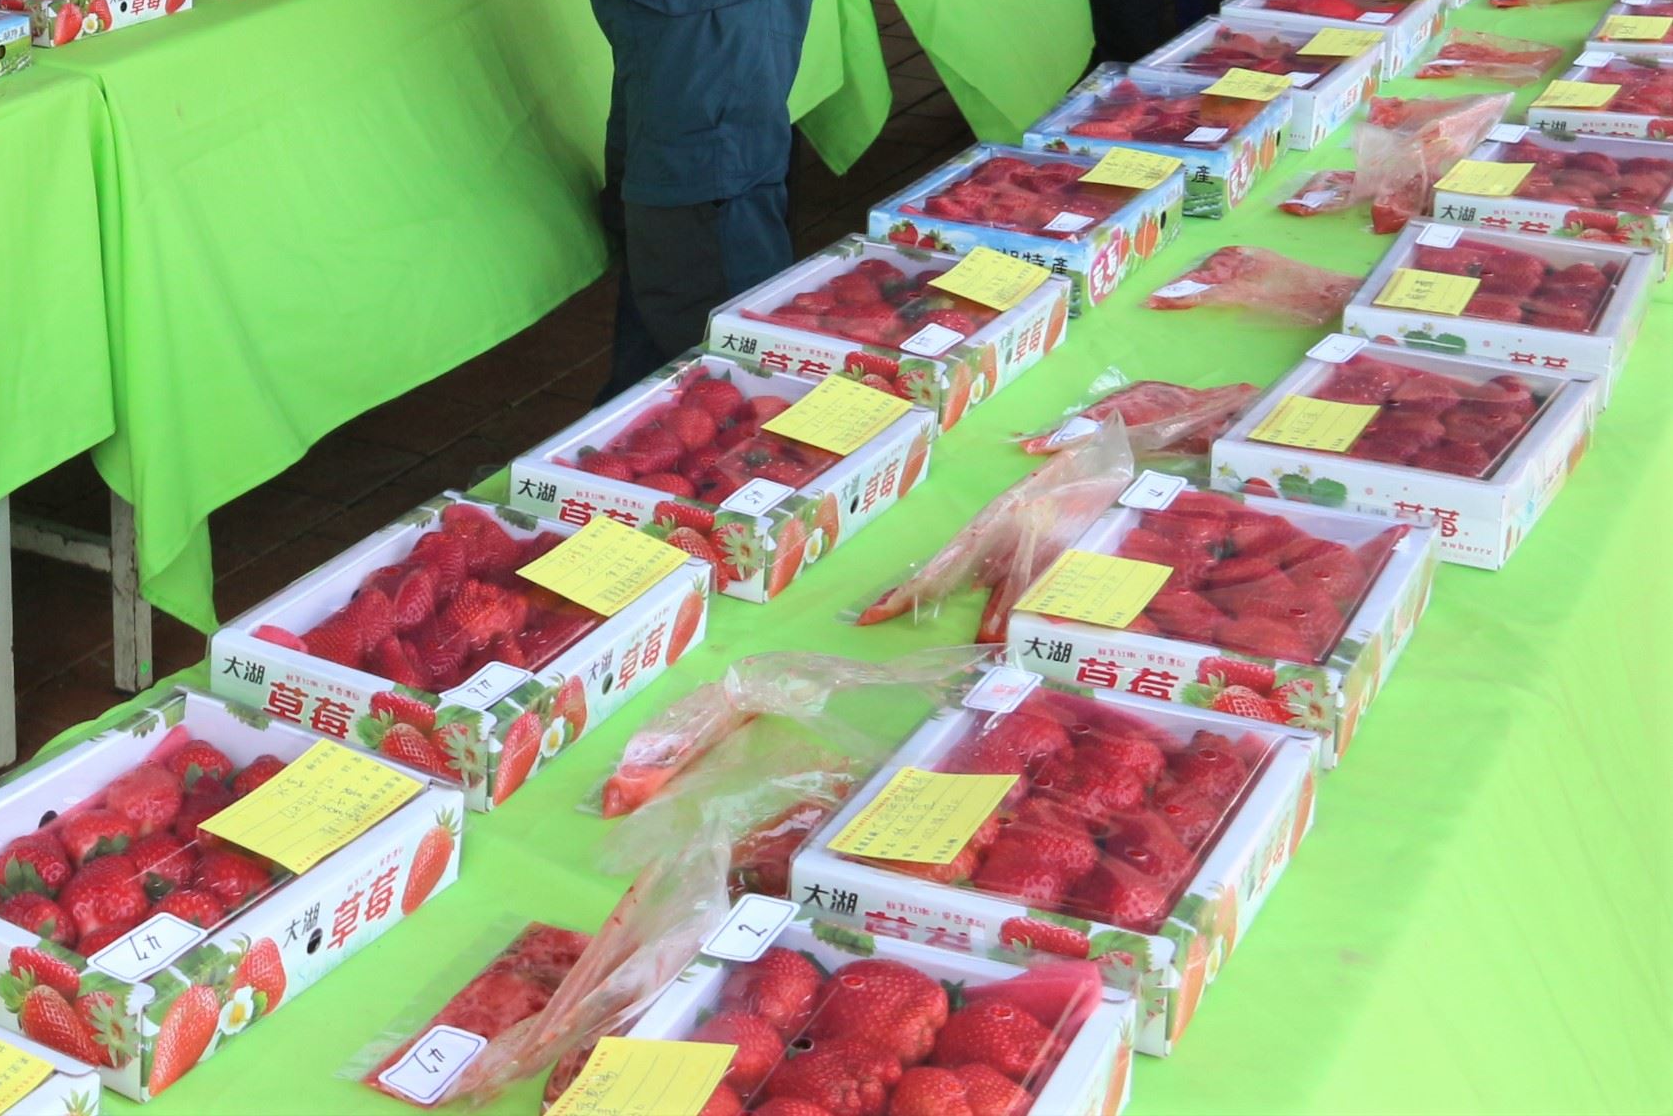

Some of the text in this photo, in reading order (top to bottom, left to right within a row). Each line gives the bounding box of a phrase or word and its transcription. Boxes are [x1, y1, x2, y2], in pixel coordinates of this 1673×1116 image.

[1439, 204, 1477, 223] 大湖
[721, 333, 758, 355] 大湖
[517, 478, 557, 503] 大湖
[860, 458, 900, 513] 草莓
[614, 621, 667, 691] 草莓
[1022, 636, 1073, 664] 大湖
[222, 655, 356, 740] 大湖 草莓
[326, 864, 400, 950] 草莓
[802, 883, 858, 915] 大湖
